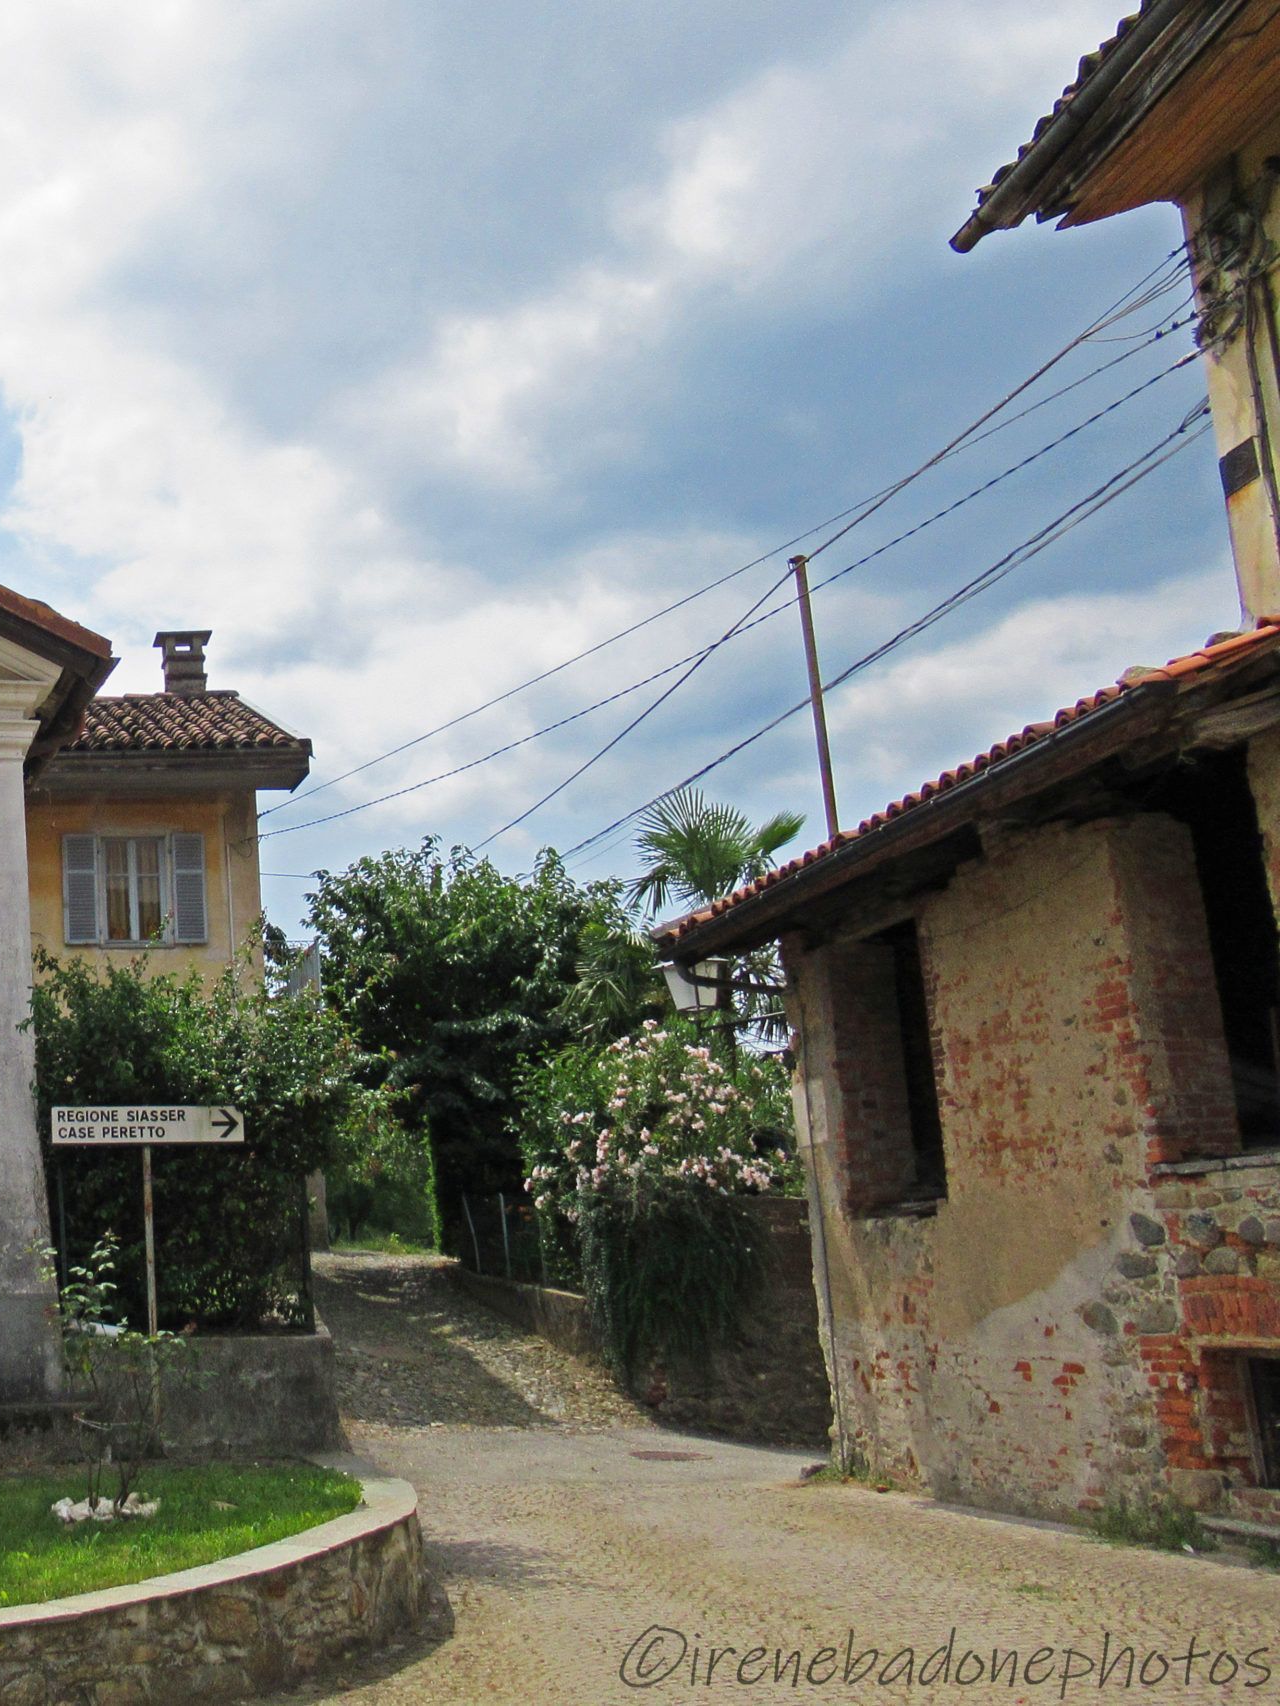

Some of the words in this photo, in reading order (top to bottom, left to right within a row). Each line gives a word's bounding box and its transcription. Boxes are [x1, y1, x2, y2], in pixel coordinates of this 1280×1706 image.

[57, 1110, 118, 1122] REGIONE
[127, 1110, 186, 1121] SIASSER
[58, 1127, 95, 1138] CASE
[102, 1126, 165, 1138] PERETTO
